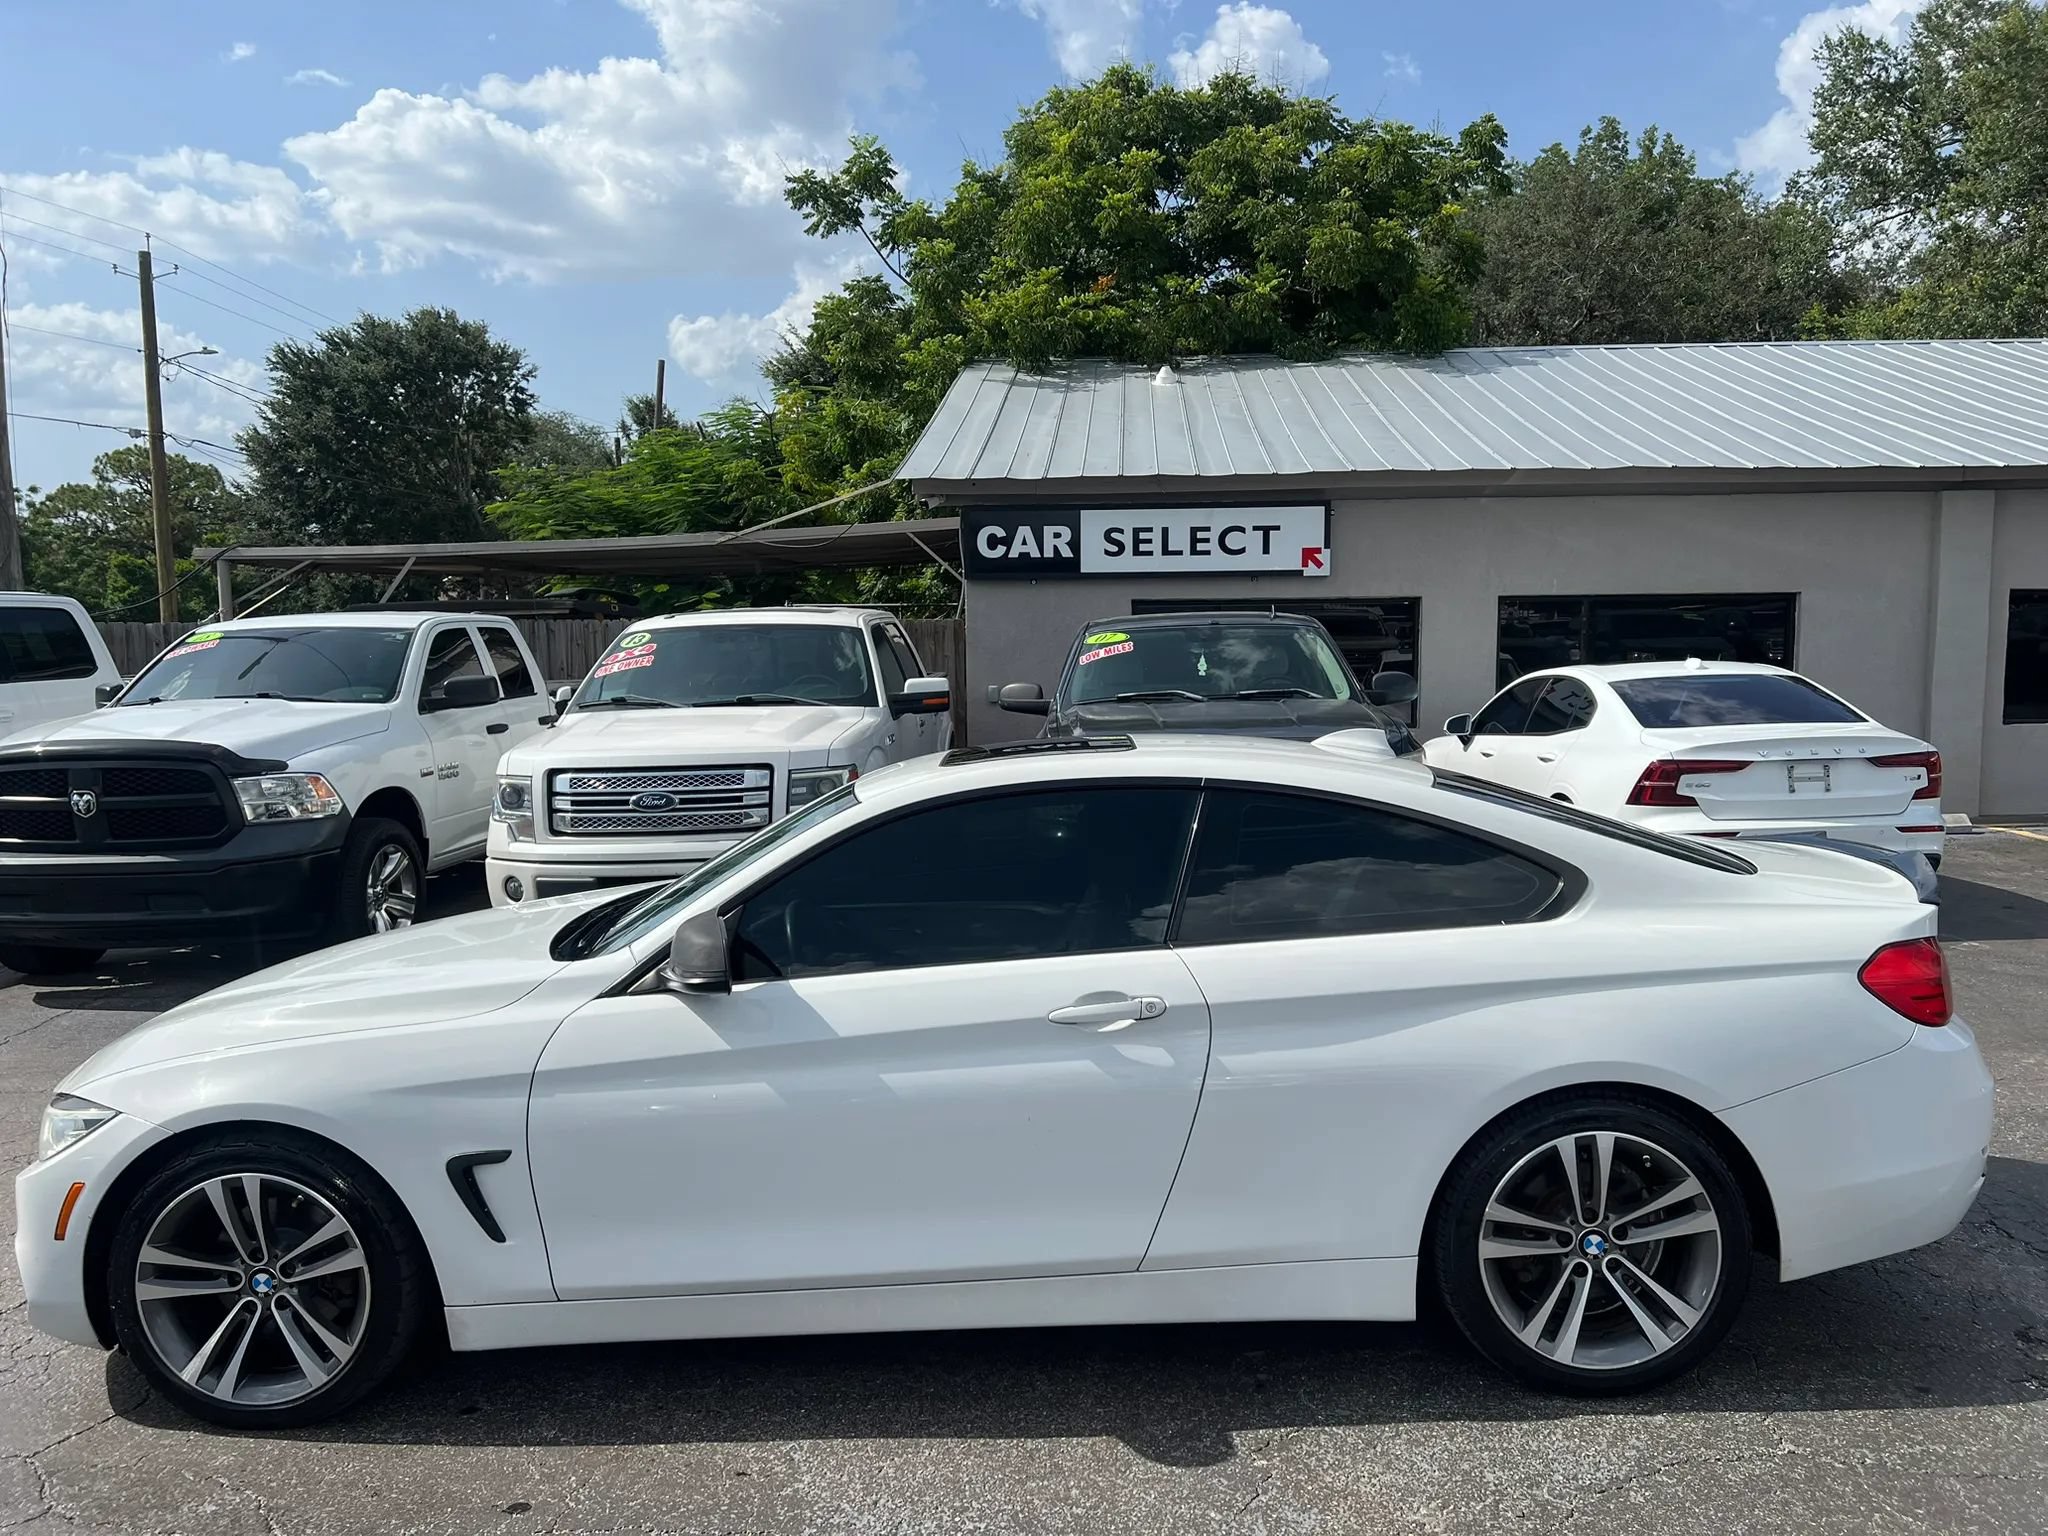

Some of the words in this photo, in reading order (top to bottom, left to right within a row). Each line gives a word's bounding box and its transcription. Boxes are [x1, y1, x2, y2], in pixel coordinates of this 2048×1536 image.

[976, 525, 1074, 558] CAR
[1103, 525, 1281, 557] SELECT
[624, 635, 646, 646] 13
[1080, 650, 1100, 664] LOW
[1103, 642, 1133, 656] MILES
[595, 664, 615, 677] ONE
[617, 656, 653, 671] OWNER
[1758, 747, 1866, 758] VOLVO
[640, 796, 667, 806] Ford
